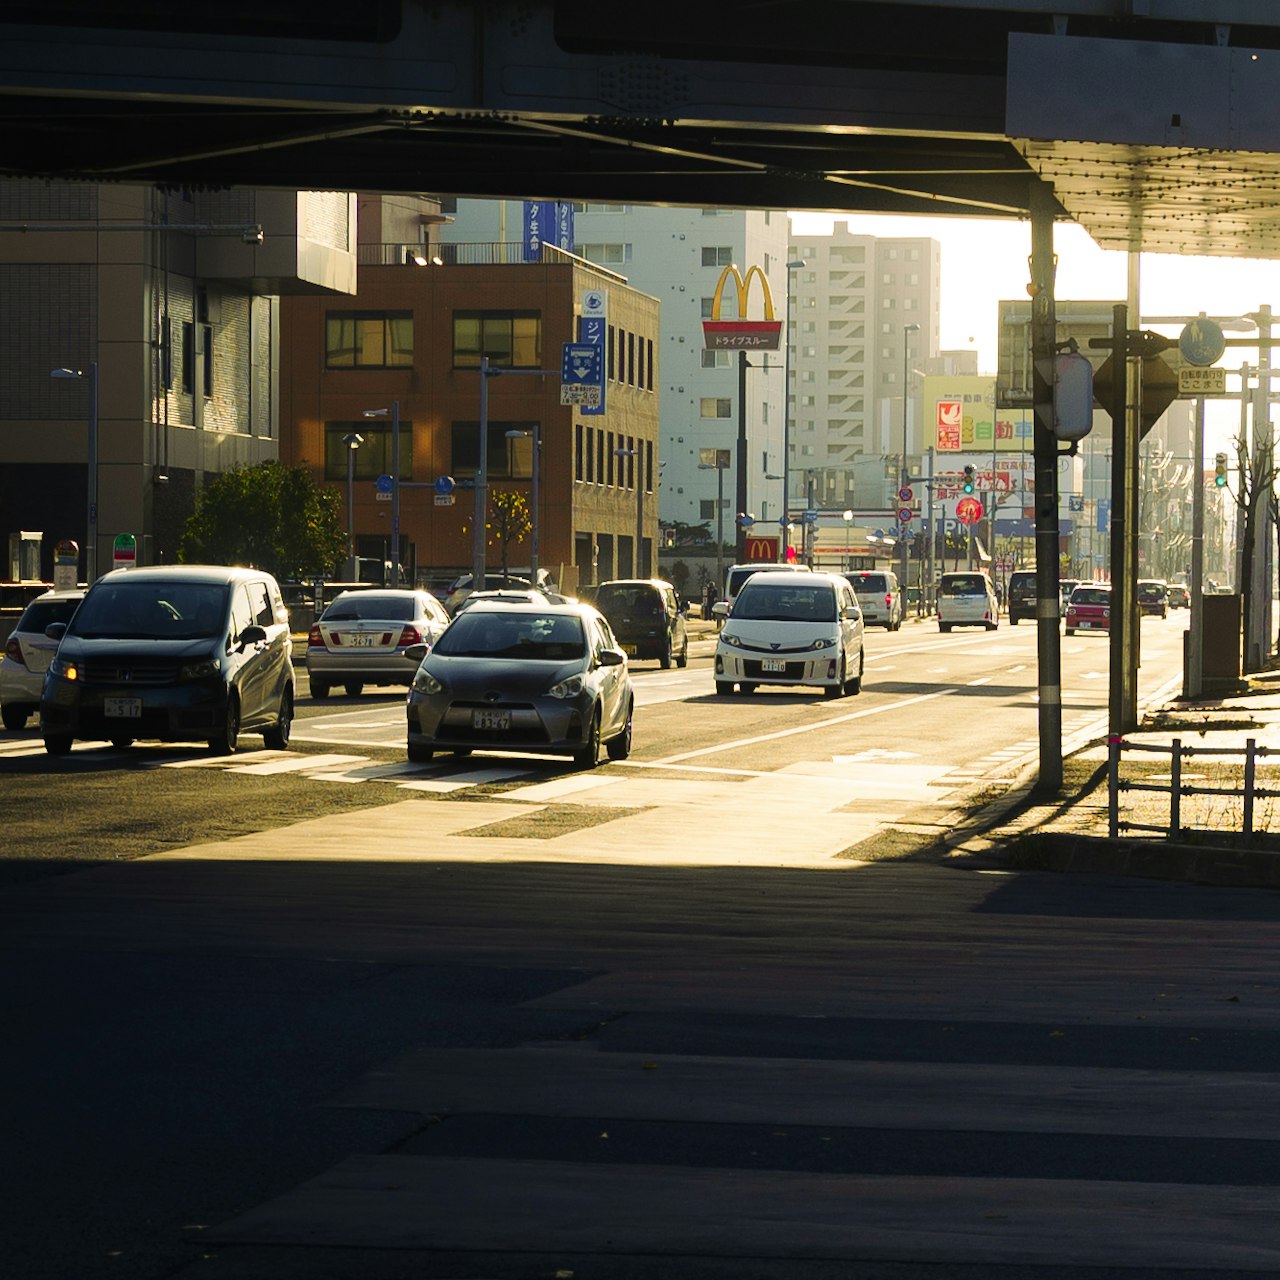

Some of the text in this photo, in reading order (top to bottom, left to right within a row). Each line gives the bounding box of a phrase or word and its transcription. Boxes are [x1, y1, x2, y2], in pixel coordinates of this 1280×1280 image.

[715, 336, 769, 345] ドライブスルー
[1181, 380, 1223, 389] ここまで
[481, 718, 509, 729] 83-67
